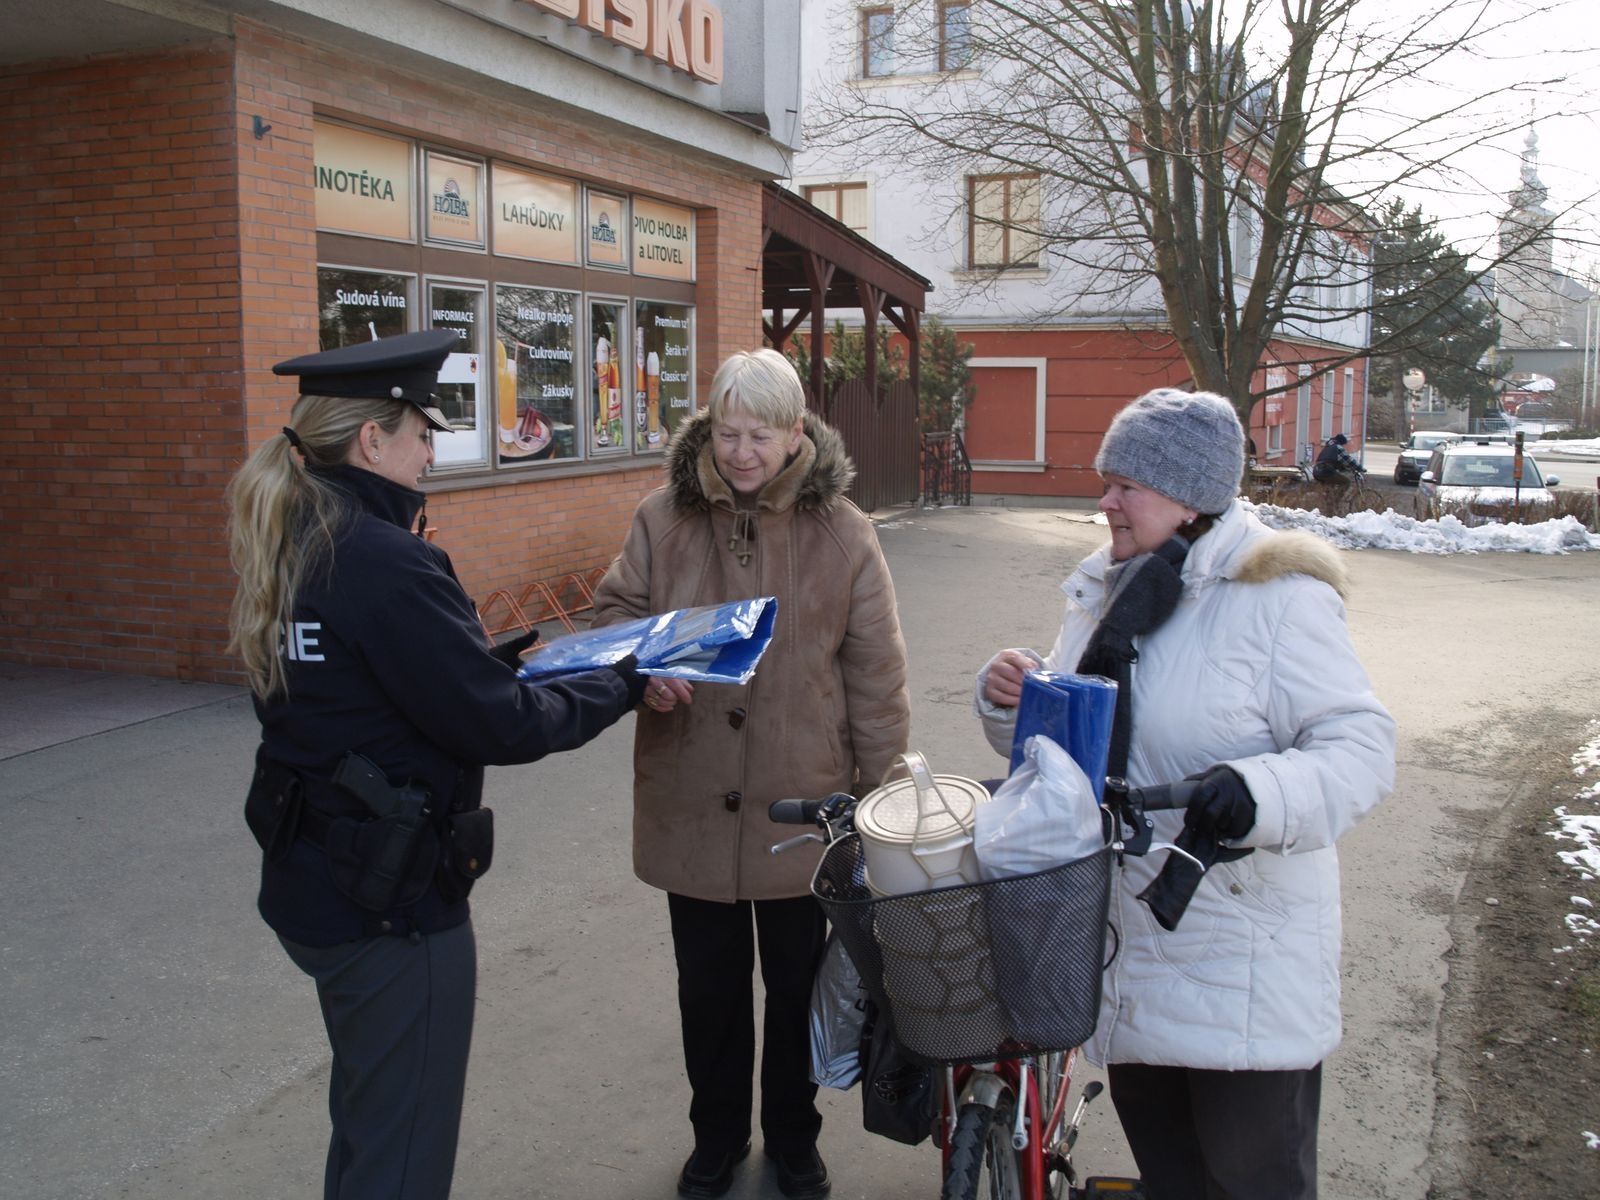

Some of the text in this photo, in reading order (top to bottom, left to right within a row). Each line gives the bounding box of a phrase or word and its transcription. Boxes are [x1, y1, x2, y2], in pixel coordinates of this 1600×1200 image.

[529, 0, 723, 85] SKO
[433, 195, 469, 217] HOLBA
[503, 203, 565, 231] LAHŮDKY
[658, 221, 688, 241] HOLBA
[639, 245, 683, 264] a LITOVEL
[336, 289, 406, 308] Sudová vína
[433, 309, 474, 323] INFORMACE
[655, 316, 681, 327] Premium
[529, 346, 574, 363] Cukrovinky
[661, 371, 680, 383] Classic
[542, 384, 574, 399] Zákusky
[280, 621, 325, 661] IE
